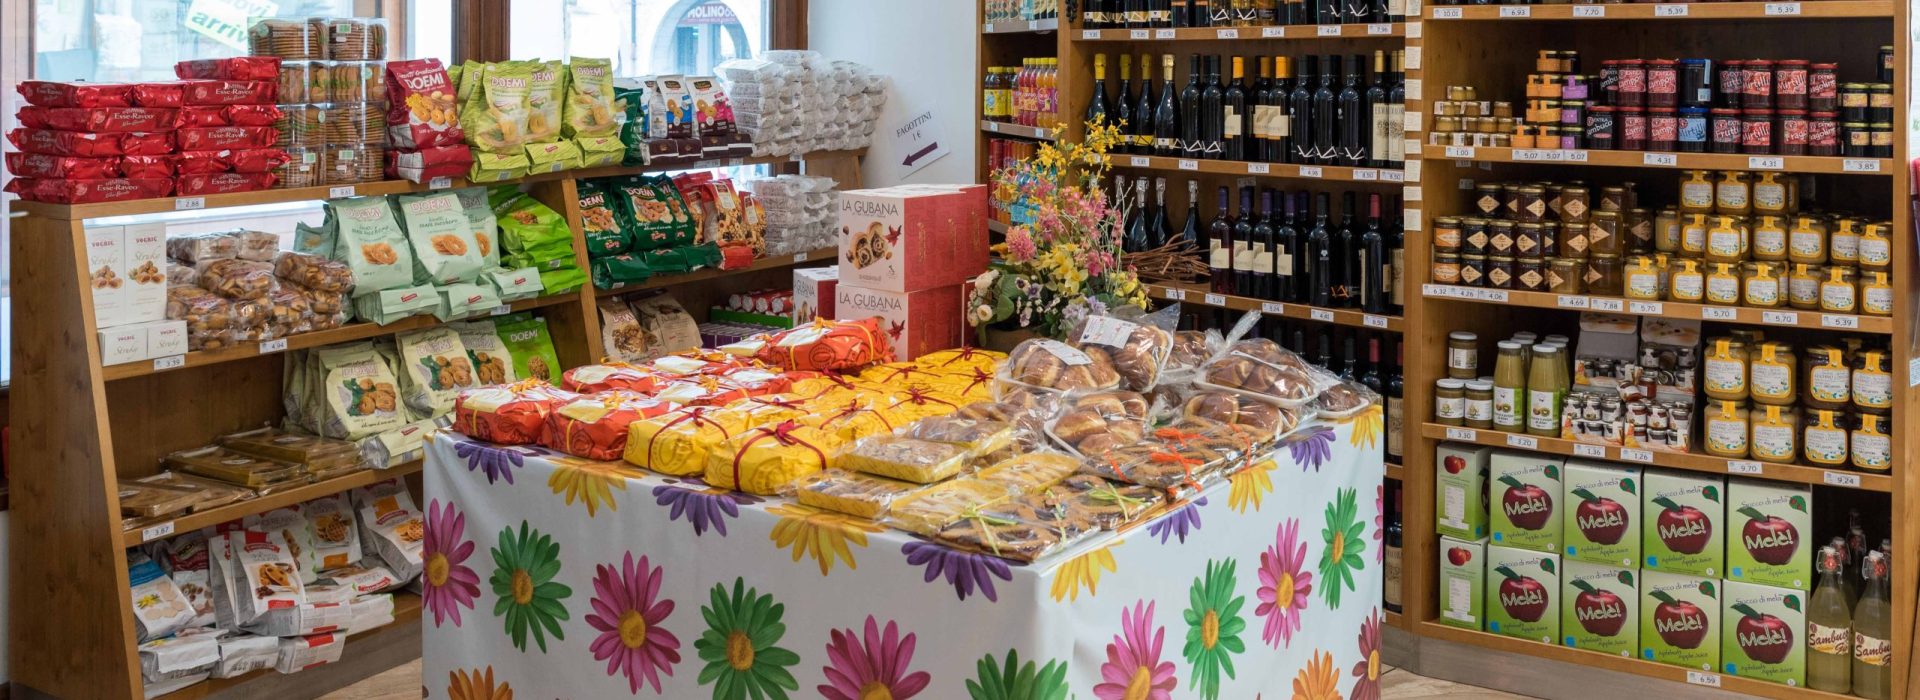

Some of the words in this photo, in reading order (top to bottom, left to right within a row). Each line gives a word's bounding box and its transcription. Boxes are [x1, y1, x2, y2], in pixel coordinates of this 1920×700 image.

[404, 73, 445, 90] DOEMI
[490, 76, 526, 88] DOEMI
[531, 71, 555, 83] OEMI
[896, 111, 932, 138] FAGOTTINI
[626, 186, 656, 198] DOEMI
[410, 198, 452, 213] DOEMI
[579, 194, 605, 208] OEMI
[842, 199, 853, 212] LA
[853, 201, 899, 217] GUBANA
[839, 292, 851, 304] LA
[852, 293, 902, 311] GUBANA
[510, 329, 538, 342] DOEMI
